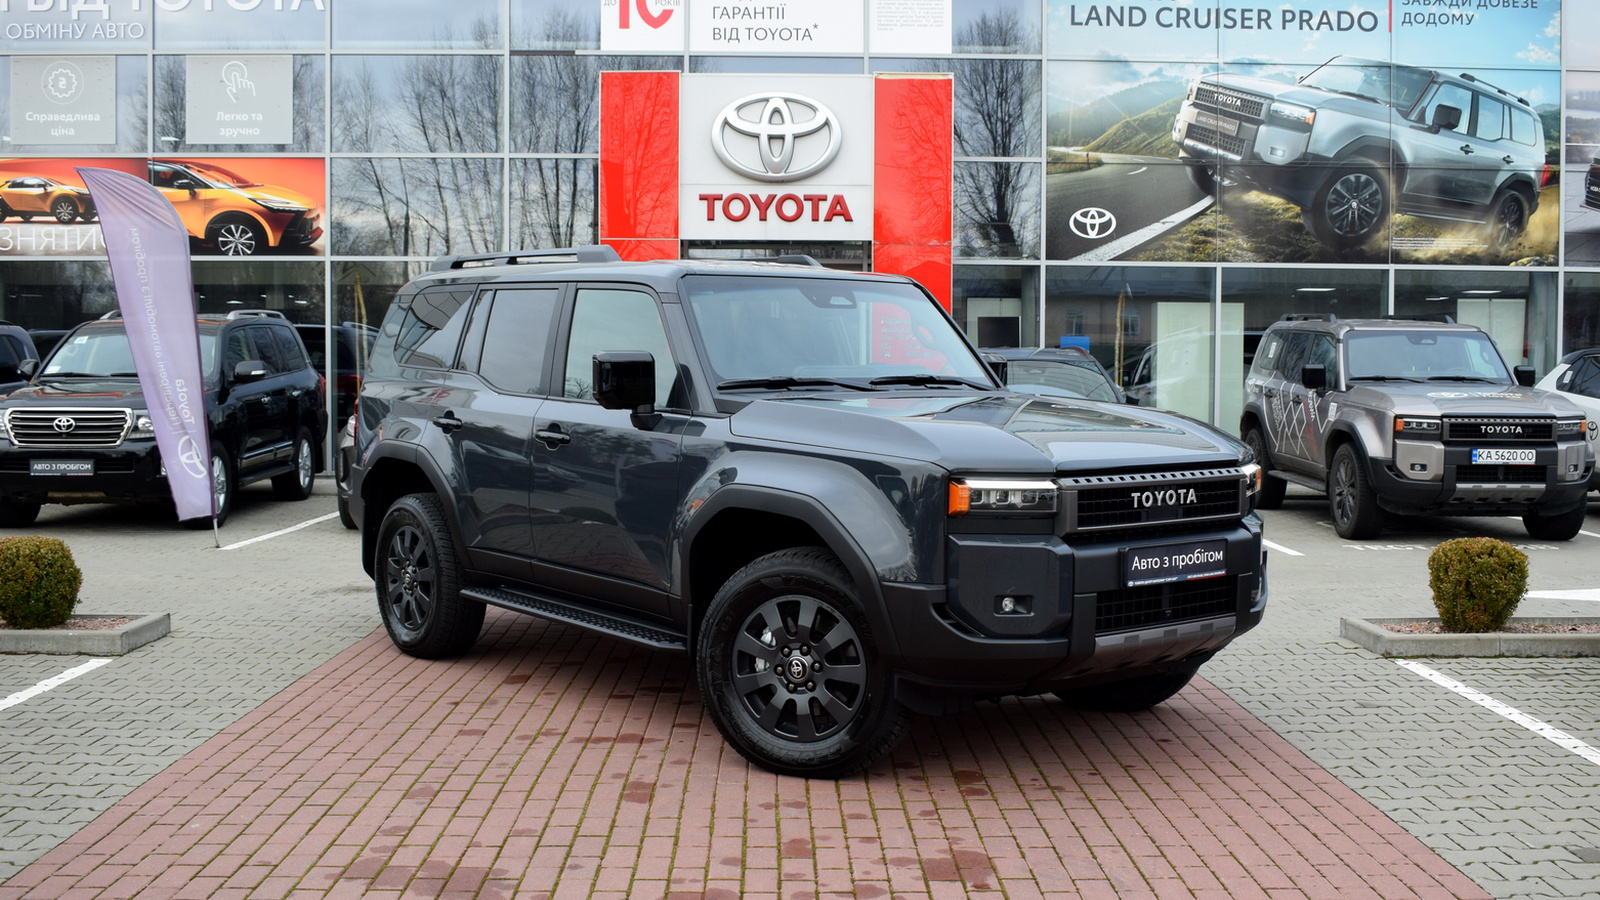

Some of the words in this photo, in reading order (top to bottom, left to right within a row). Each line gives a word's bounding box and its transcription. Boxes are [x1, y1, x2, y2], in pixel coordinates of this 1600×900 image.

[712, 4, 787, 20] ГАРАНТІЇ
[1476, 0, 1538, 9] ДОВЕЗЕ
[1070, 5, 1147, 27] LAND
[1155, 7, 1272, 30] CRUISER
[1281, 9, 1379, 33] PRADO
[1401, 12, 1475, 27] ДОДОМУ
[6, 23, 87, 39] ОБМІНУ
[92, 23, 145, 39] АВТО
[712, 28, 740, 43] ВІД
[1214, 93, 1241, 106] TOYOTA
[25, 112, 101, 124] Справедлива
[215, 112, 248, 122] Легко
[251, 113, 263, 122] та
[51, 126, 75, 137] ціна
[219, 127, 260, 137] зручно
[699, 193, 854, 222] TOYOTA
[0, 227, 106, 251] ЗНЯТИ
[1480, 425, 1523, 434] TOYOTA
[1478, 450, 1493, 461] KA
[1494, 450, 1518, 461] 5620
[1131, 488, 1197, 508] TOYOTA
[1131, 555, 1161, 571] Авто
[1162, 556, 1170, 568] з
[1171, 548, 1224, 569] пробігом
